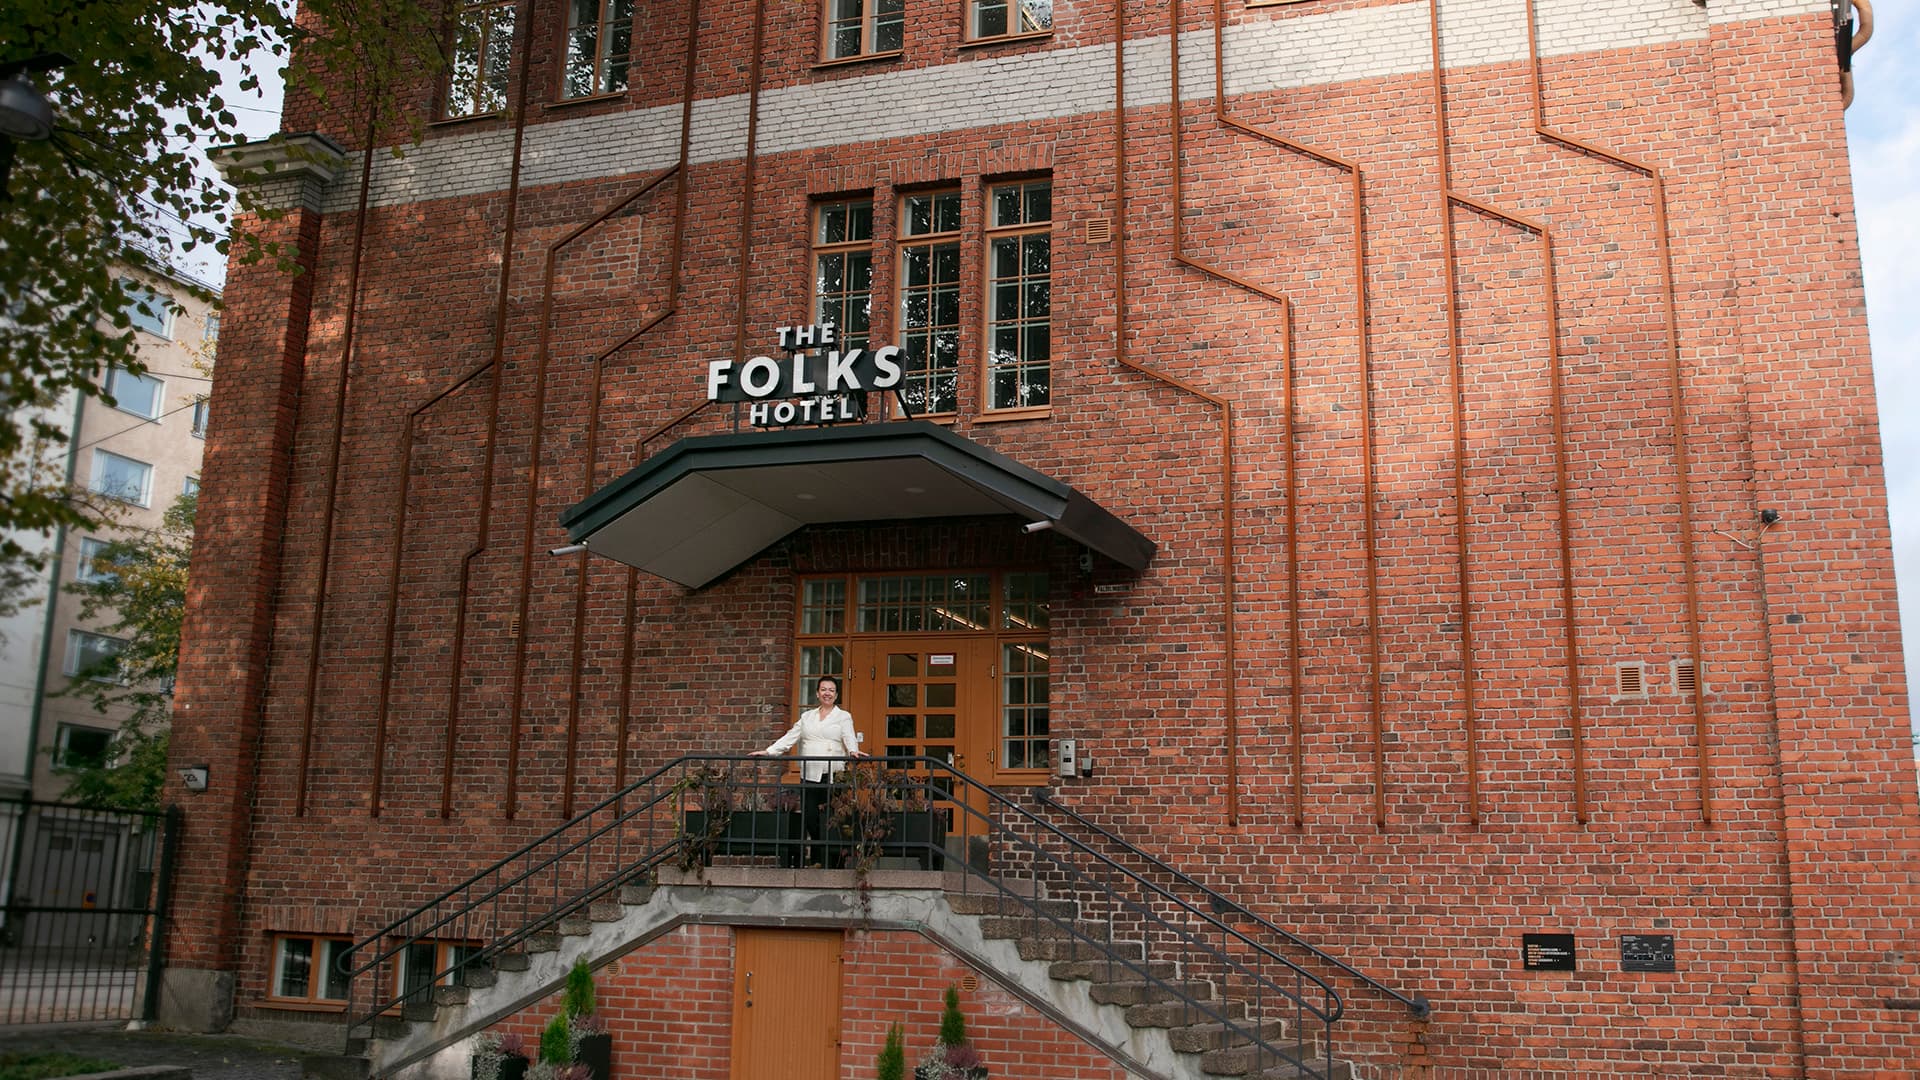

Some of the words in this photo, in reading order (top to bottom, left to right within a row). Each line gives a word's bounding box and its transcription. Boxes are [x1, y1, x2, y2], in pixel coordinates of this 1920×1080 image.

[776, 322, 836, 347] THE
[708, 345, 901, 399] FOLKS
[750, 397, 853, 424] HOTEL
